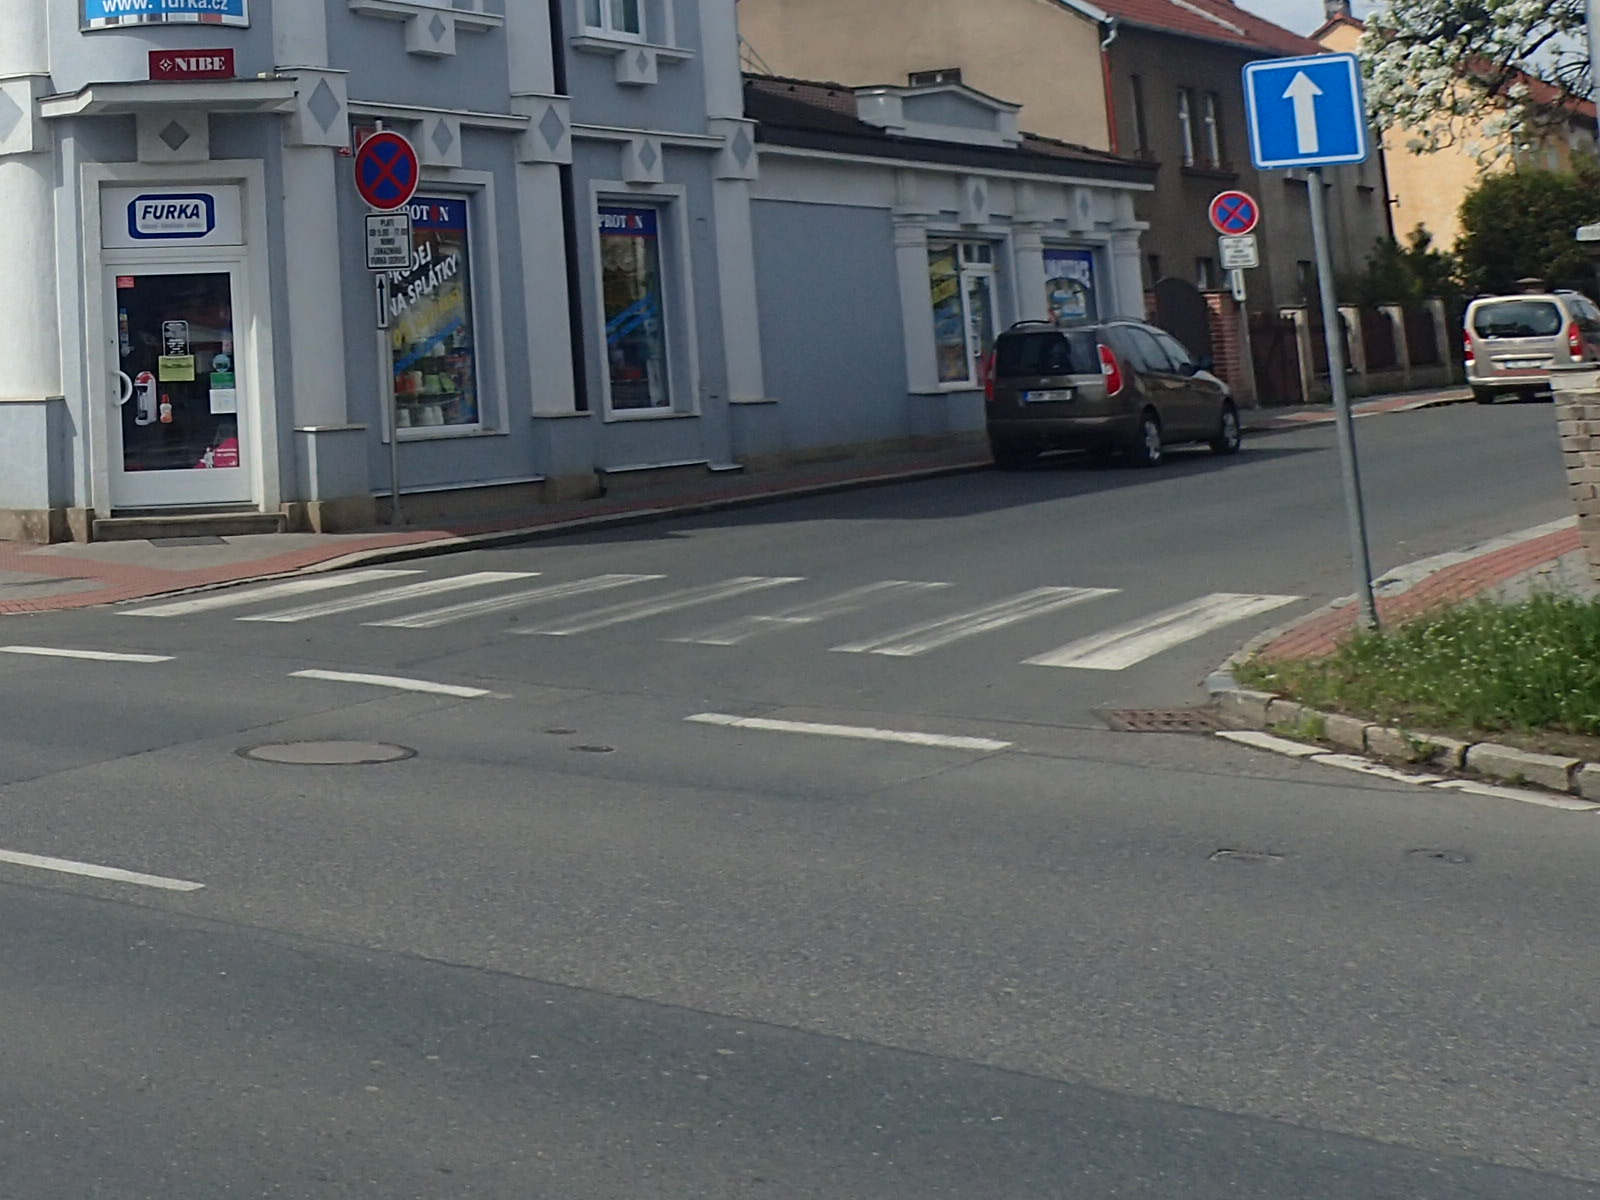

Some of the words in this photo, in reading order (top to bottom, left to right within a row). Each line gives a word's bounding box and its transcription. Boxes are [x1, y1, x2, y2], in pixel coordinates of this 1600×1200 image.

[175, 57, 225, 71] NIBE
[142, 204, 199, 220] FURKA
[407, 254, 457, 304] SPLÁTKY
